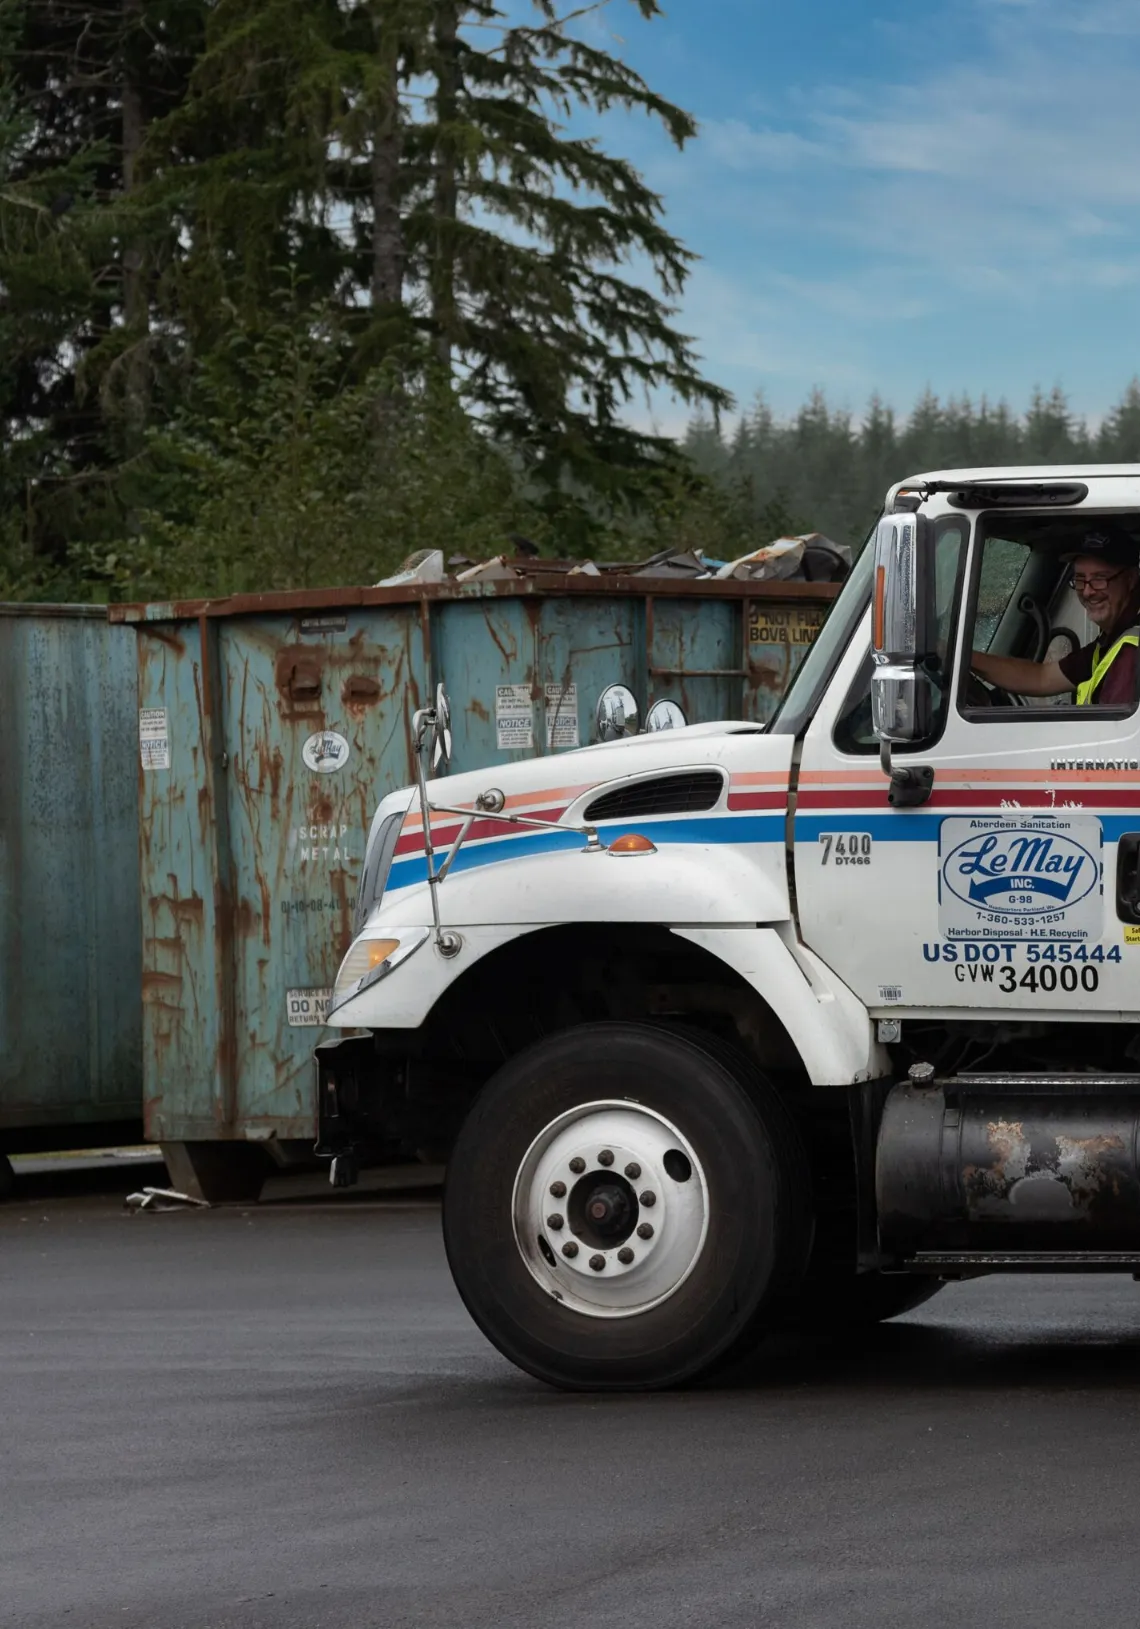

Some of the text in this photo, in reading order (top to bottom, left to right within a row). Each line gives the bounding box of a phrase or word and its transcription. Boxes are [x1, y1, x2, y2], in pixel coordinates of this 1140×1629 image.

[750, 627, 788, 642] BOVE
[499, 719, 530, 728] NOTICE
[970, 819, 1071, 829] Aberdeen Sanitation
[299, 824, 348, 839] SCRAP
[301, 847, 351, 861] METAL
[820, 834, 871, 866] 7400
[835, 856, 871, 866] DT466
[1010, 878, 1035, 889] INC.
[976, 912, 1066, 926] 1-360-533-1257
[948, 928, 982, 936] Harbor
[982, 928, 1023, 938] Disposal
[1030, 929, 1047, 937] H.E.
[922, 943, 1122, 964] US DOT 545444
[954, 963, 1099, 993] GVW 34000
[291, 1000, 310, 1013] DO
